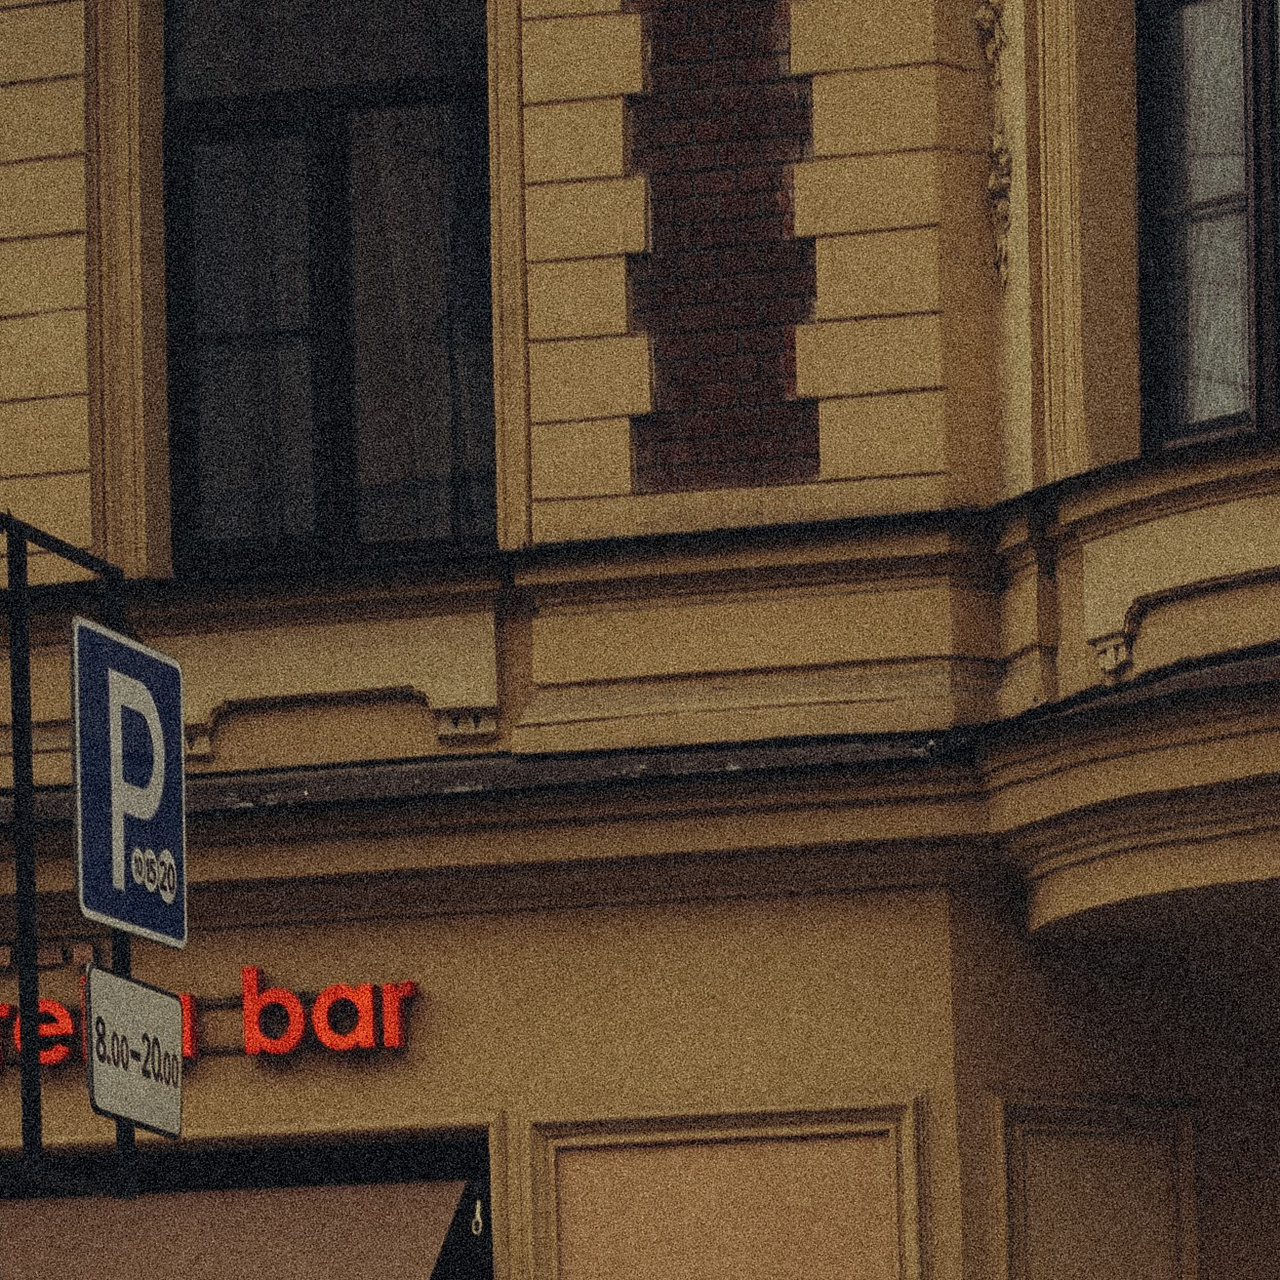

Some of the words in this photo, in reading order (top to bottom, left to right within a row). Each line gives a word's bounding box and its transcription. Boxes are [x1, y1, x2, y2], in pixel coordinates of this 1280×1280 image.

[108, 668, 165, 890] P
[160, 861, 175, 894] 20
[241, 965, 413, 1058] bar
